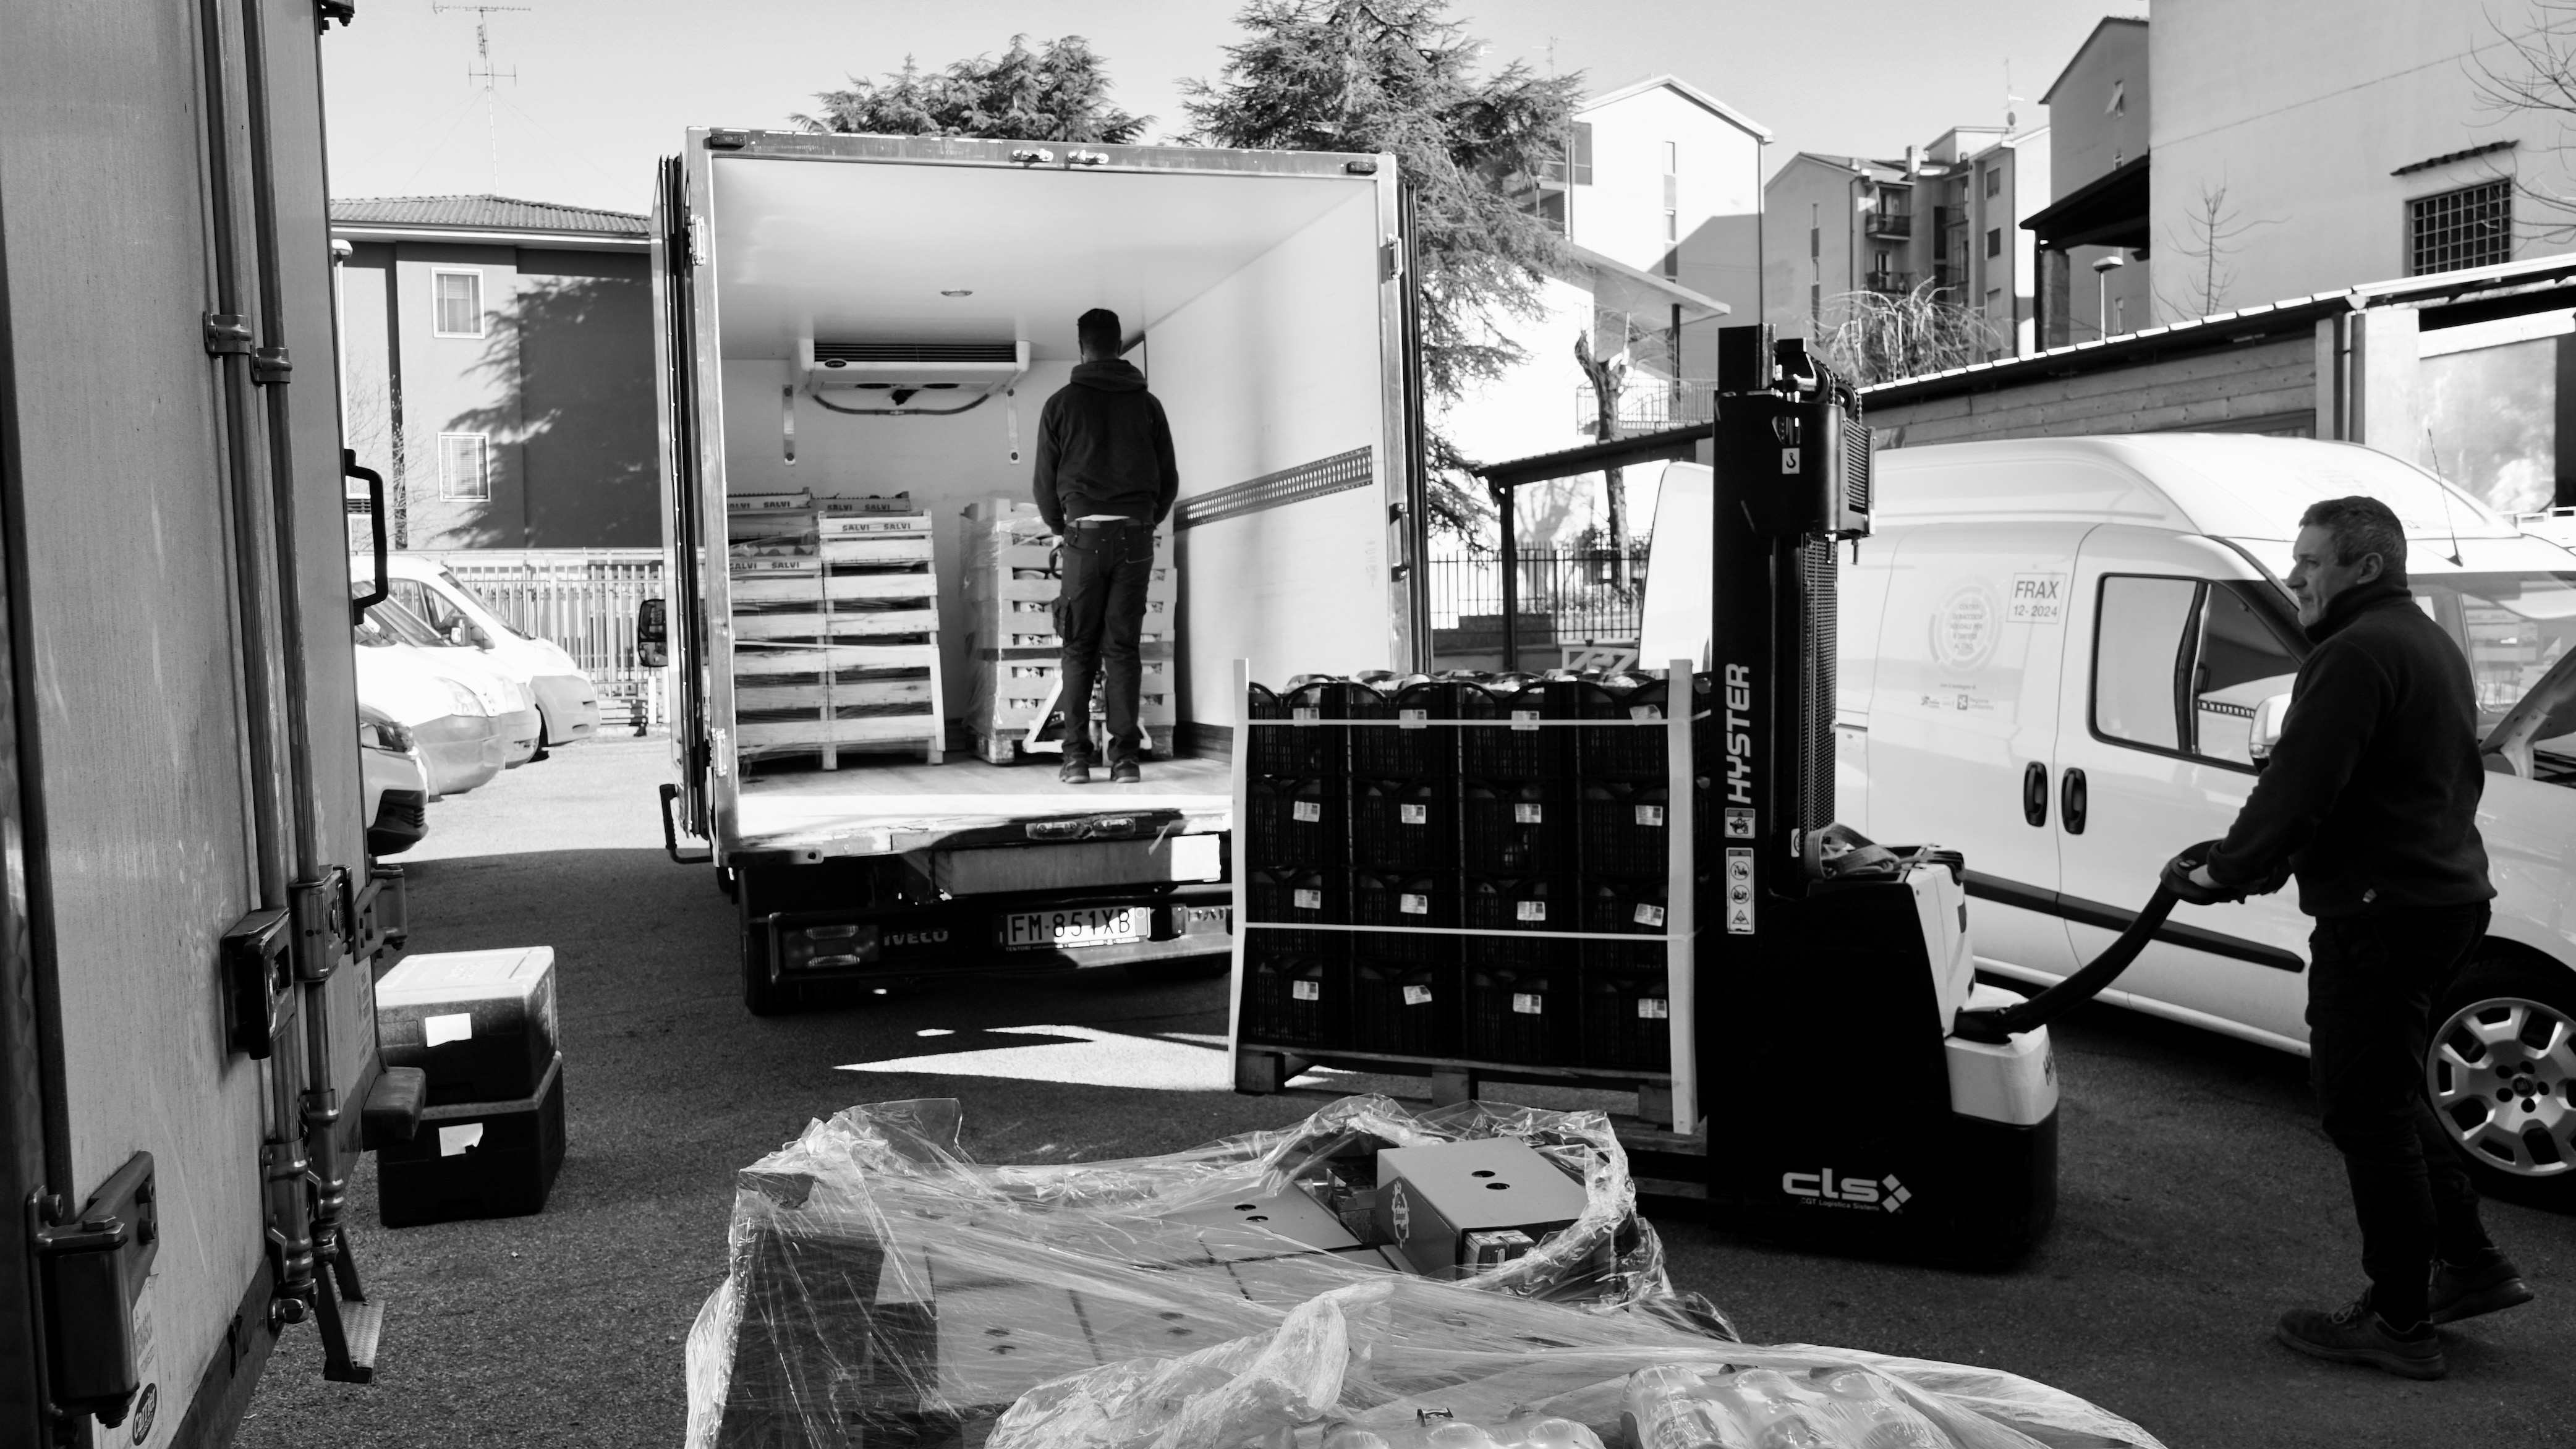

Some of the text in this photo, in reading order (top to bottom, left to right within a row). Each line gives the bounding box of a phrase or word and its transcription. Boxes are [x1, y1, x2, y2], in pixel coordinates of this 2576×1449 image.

[2015, 580, 2059, 598] FRAX
[1725, 663, 1751, 804] HYSTER
[884, 929, 948, 946] IVECO
[1783, 1168, 1879, 1203] cls
[1819, 1199, 1850, 1209] Logistica
[1853, 1202, 1880, 1212] Sistemi
